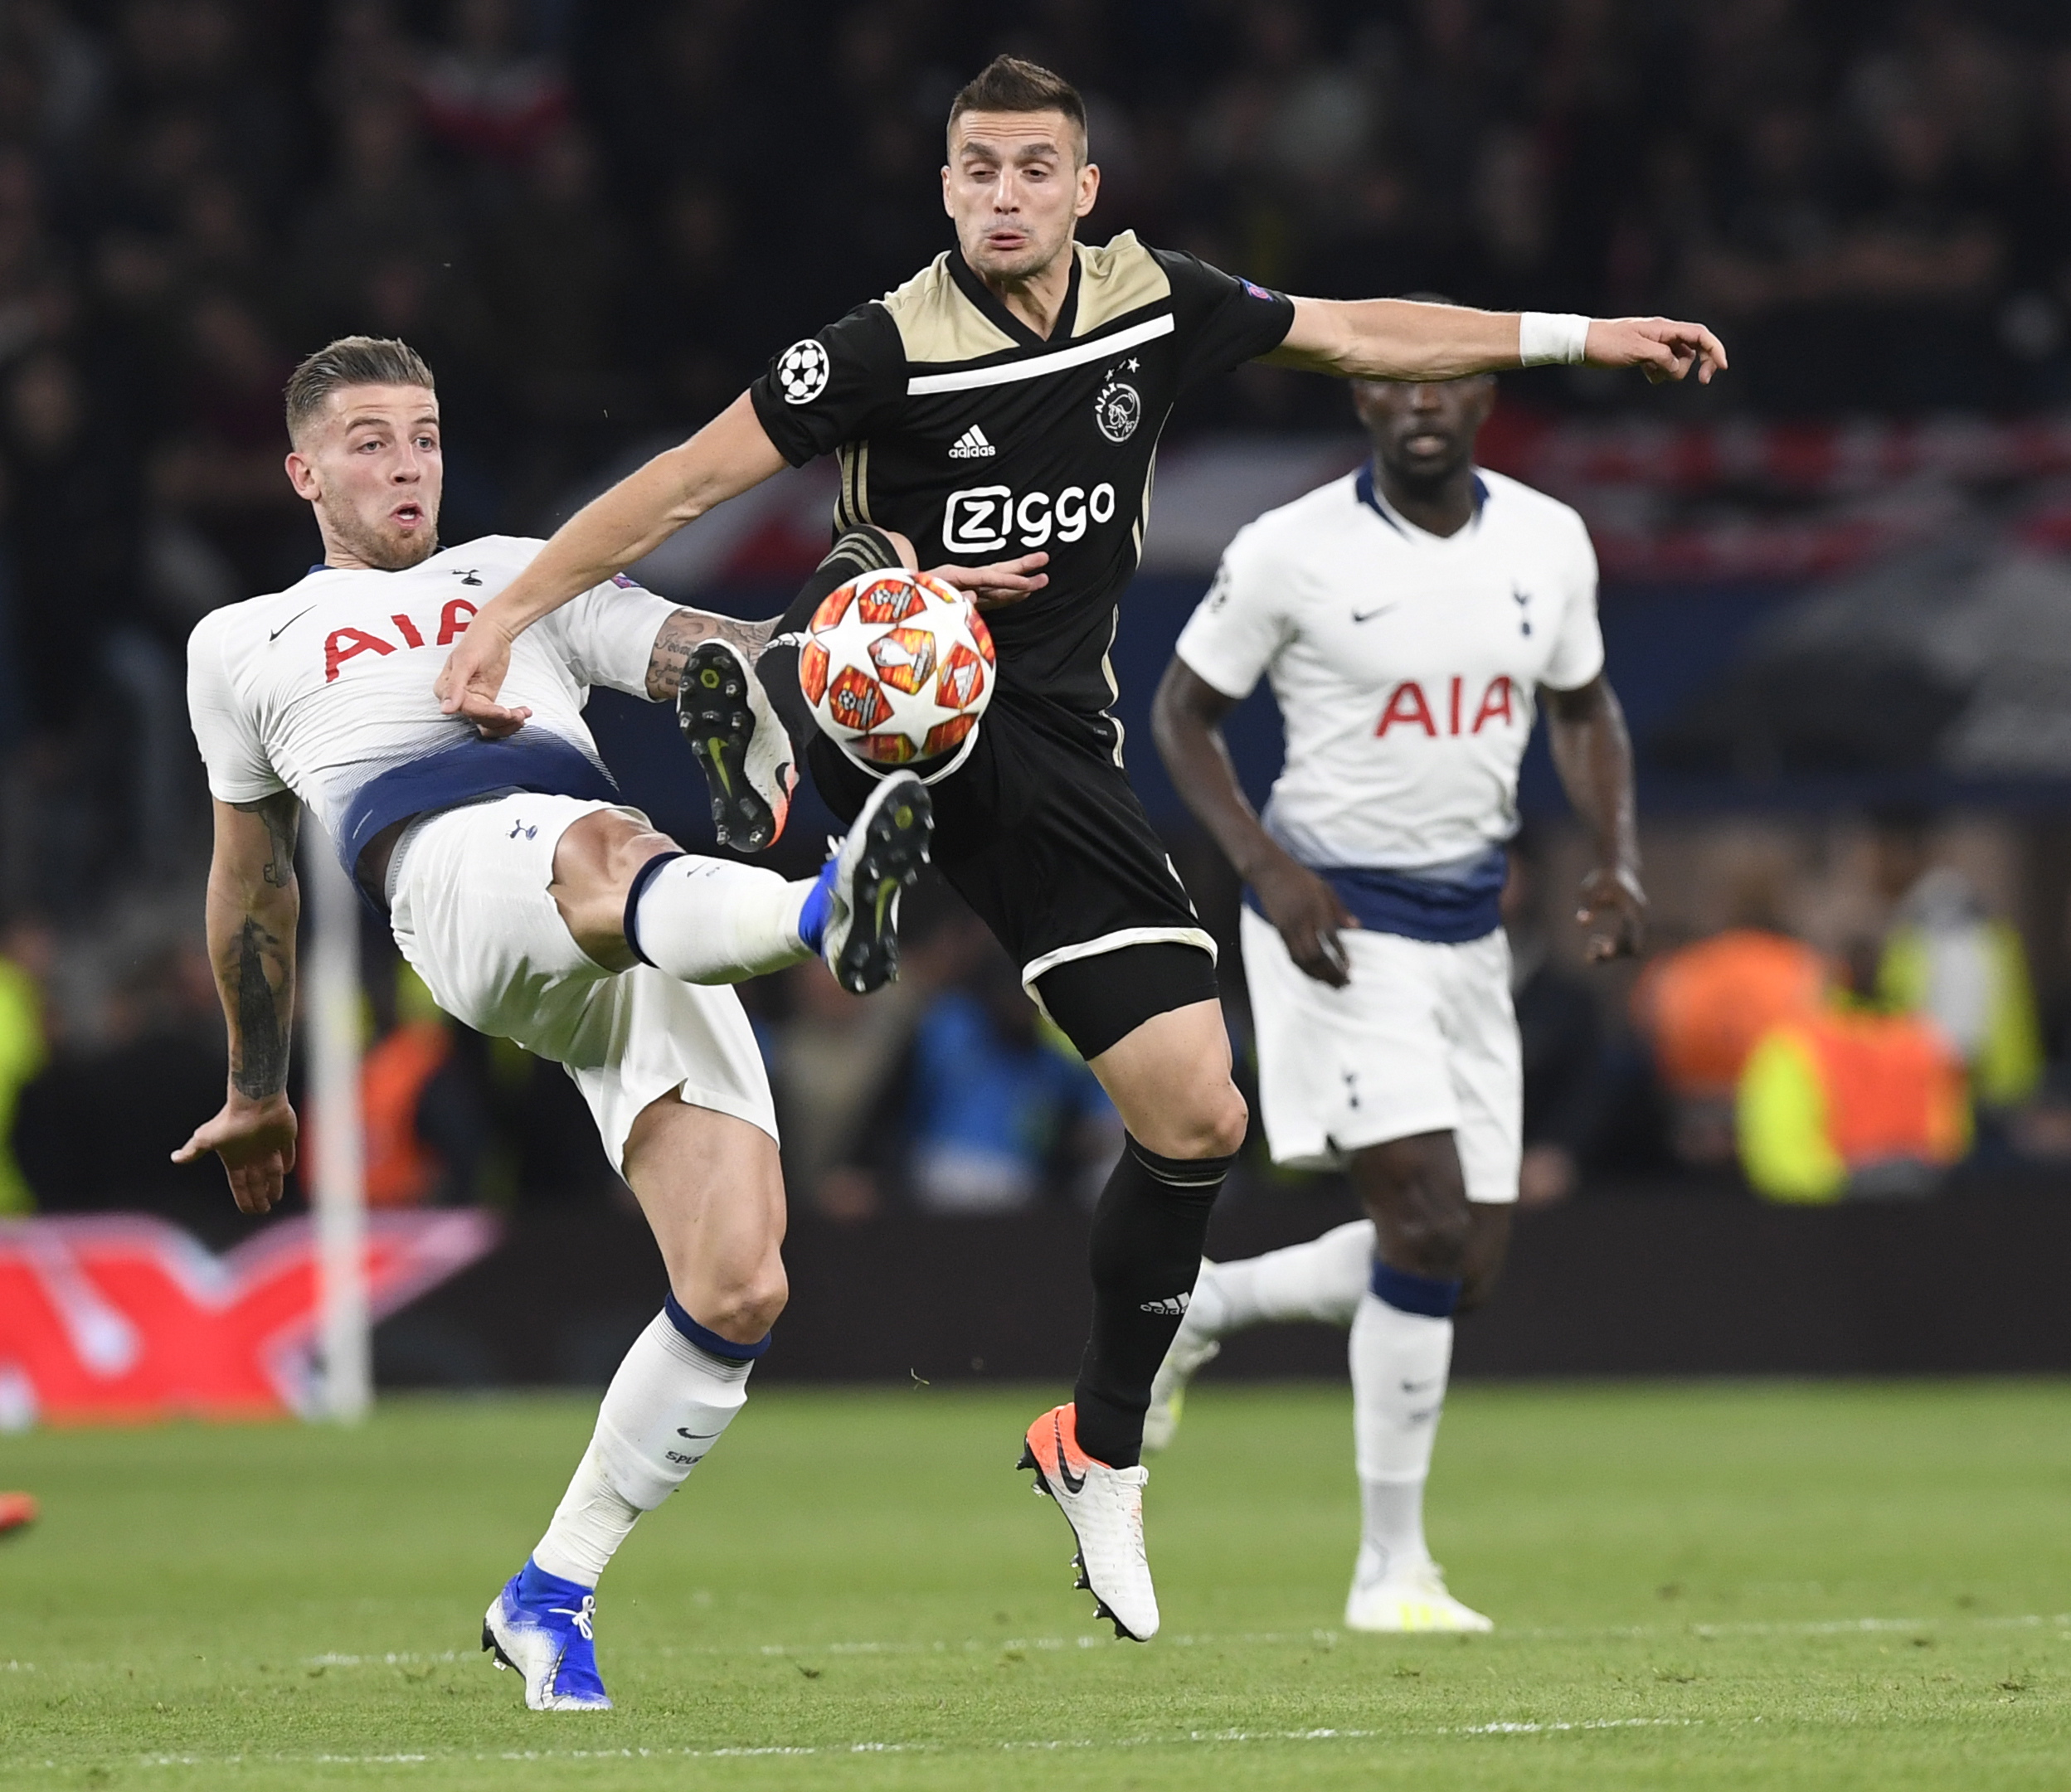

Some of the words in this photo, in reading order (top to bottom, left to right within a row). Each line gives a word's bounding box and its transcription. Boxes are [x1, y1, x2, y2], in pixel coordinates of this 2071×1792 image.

[1095, 382, 1116, 413] AJAX
[948, 445, 996, 459] adidas
[324, 599, 478, 683] AIA
[1374, 676, 1512, 737] AIA
